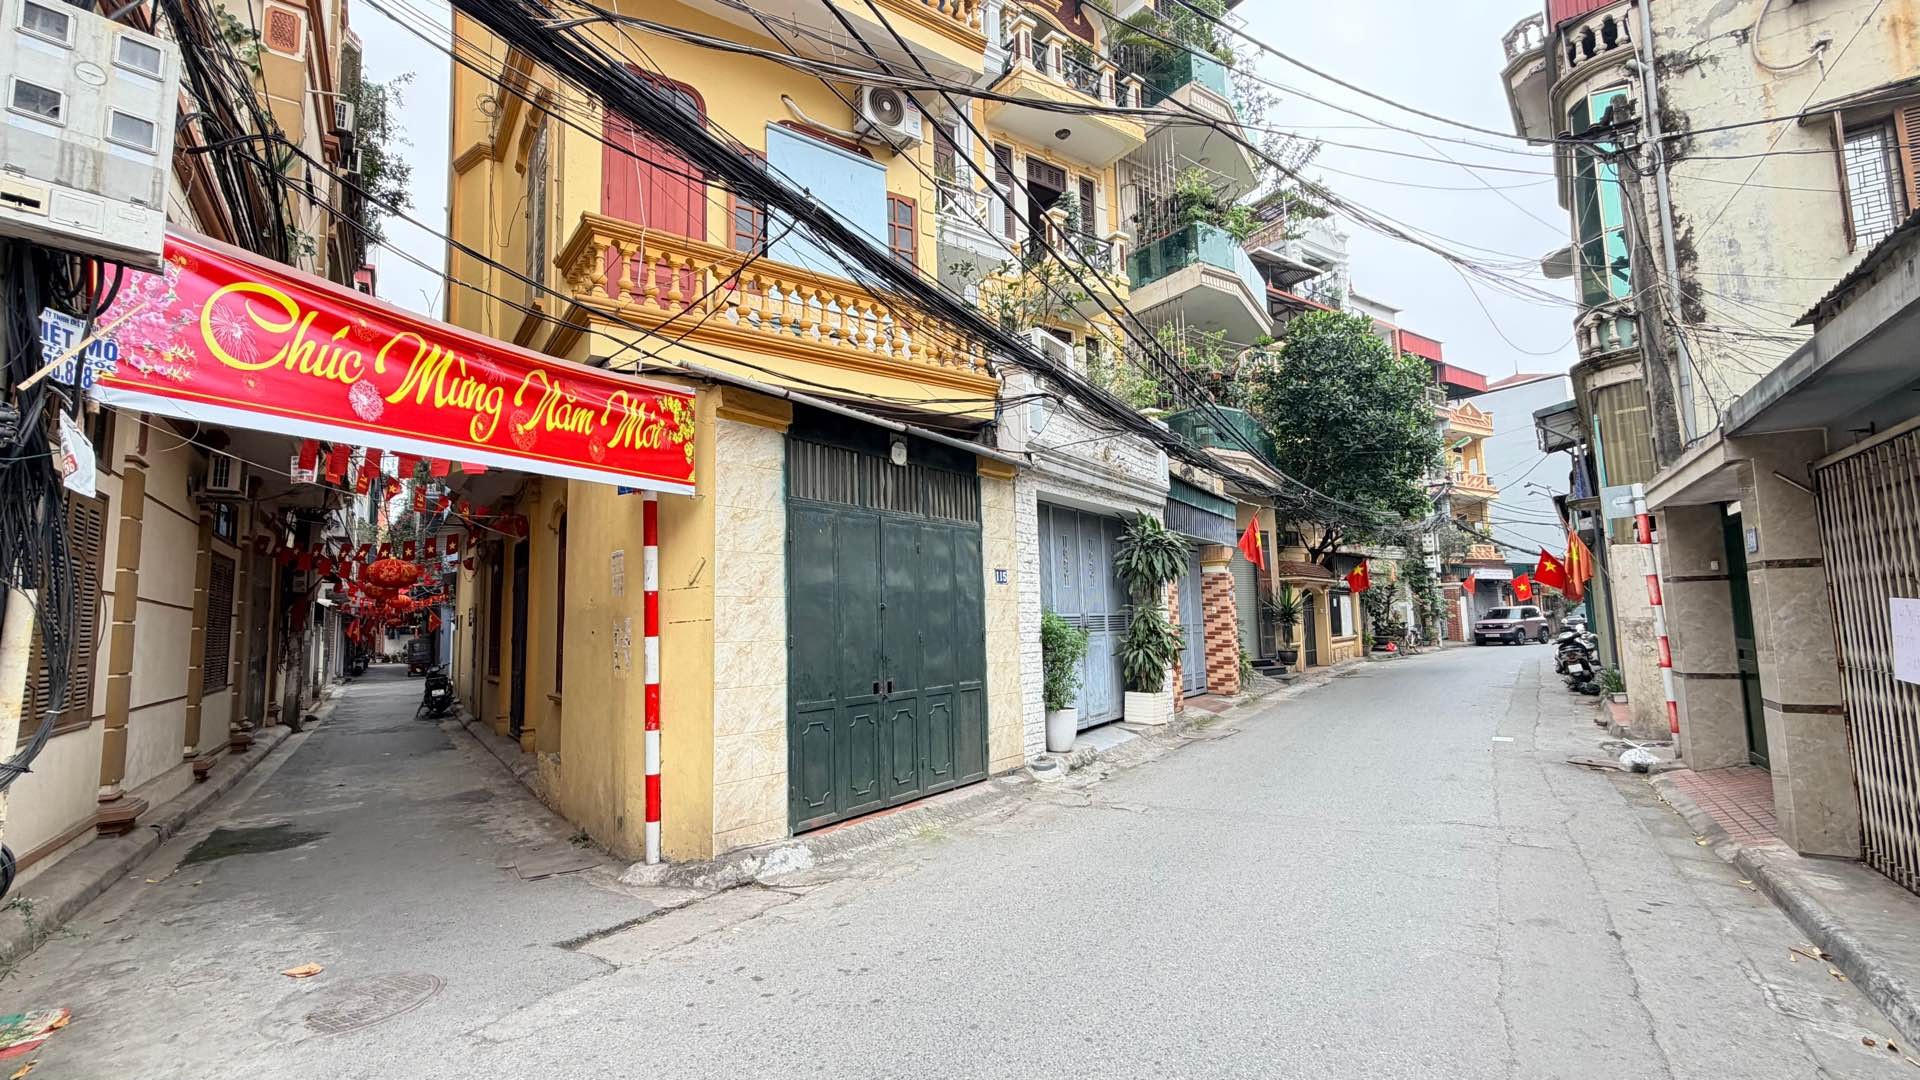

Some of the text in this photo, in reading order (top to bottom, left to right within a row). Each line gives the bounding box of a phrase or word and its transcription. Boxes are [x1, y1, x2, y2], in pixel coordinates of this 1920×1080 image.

[200, 282, 666, 450] Chúc Mừng Năm Mới
